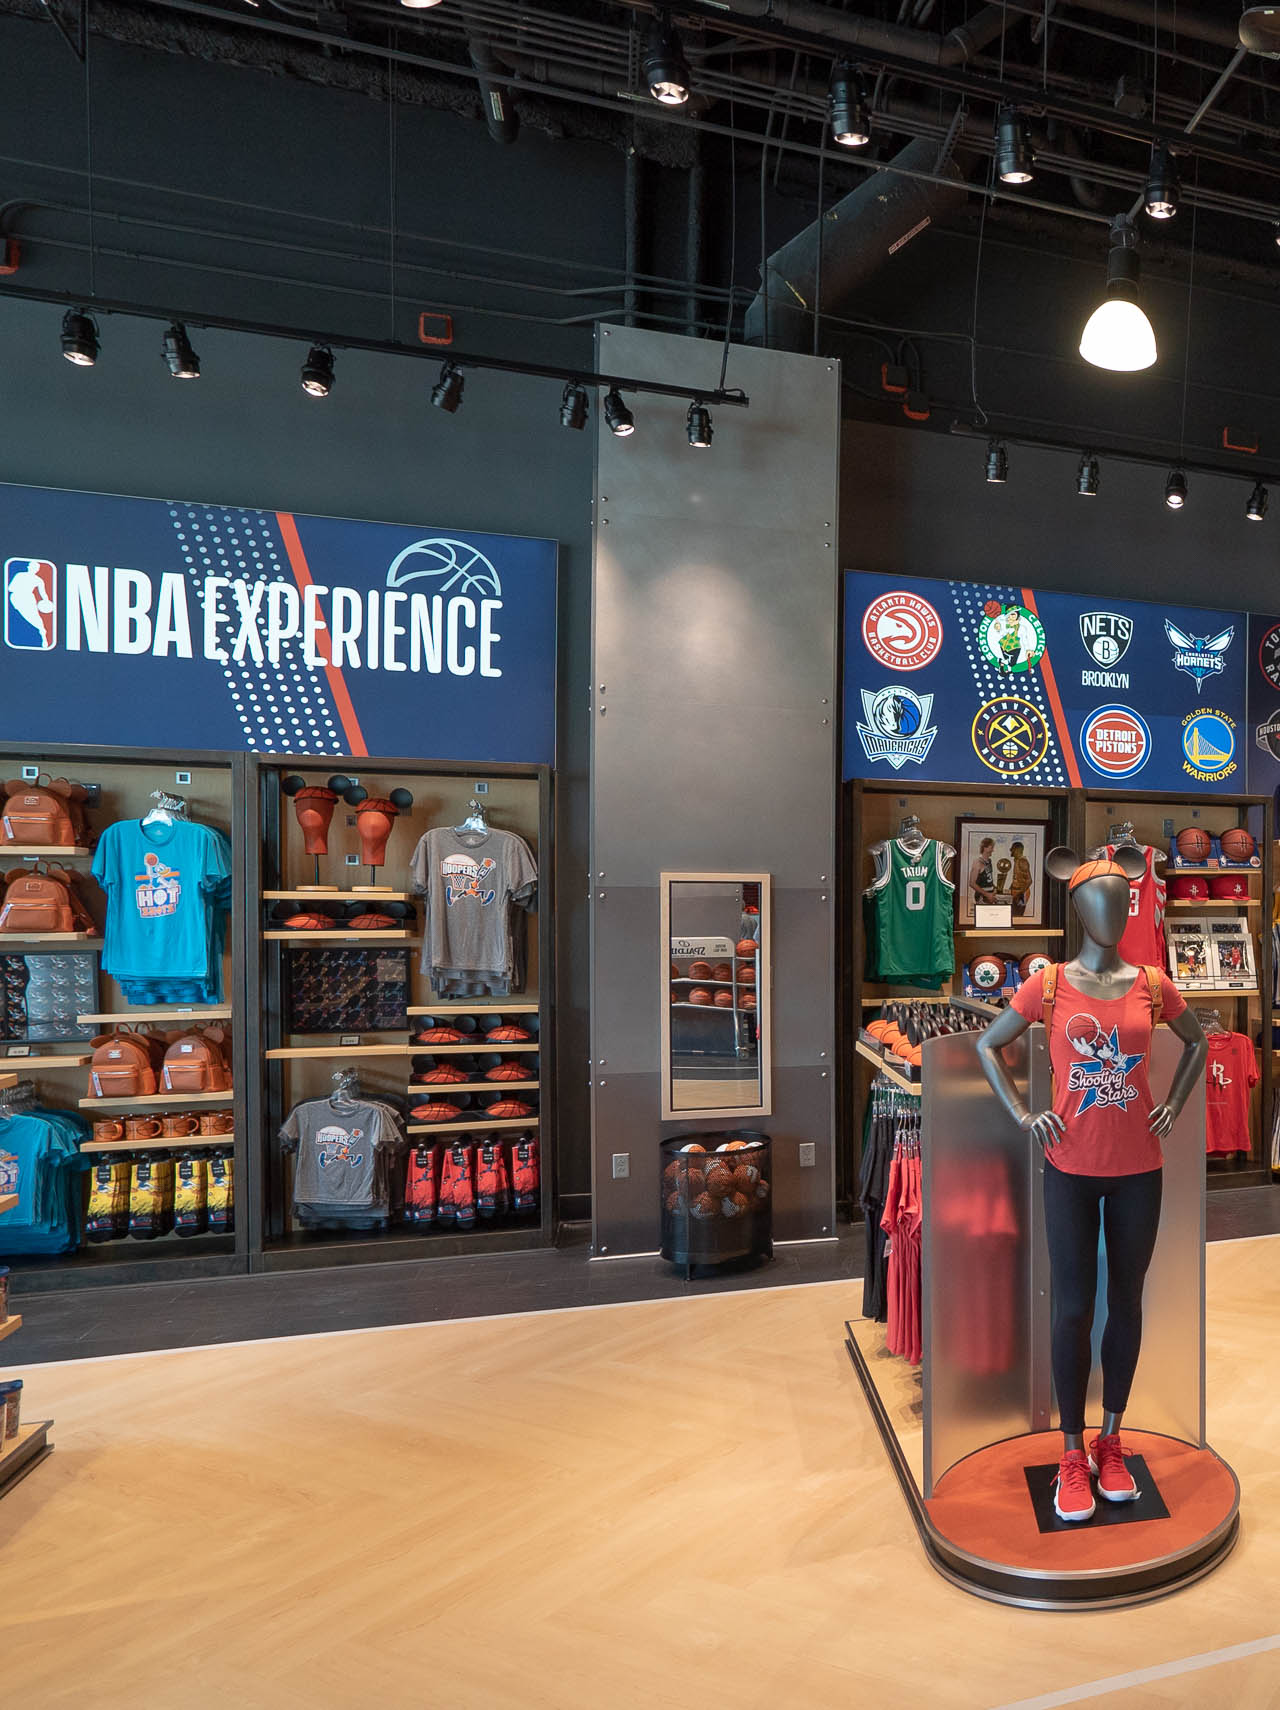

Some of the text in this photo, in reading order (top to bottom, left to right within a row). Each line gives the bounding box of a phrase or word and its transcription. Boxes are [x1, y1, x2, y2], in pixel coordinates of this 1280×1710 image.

[66, 563, 503, 677] NBA EXPERIENCE
[869, 597, 936, 627] ATLANTA HAWKS
[1028, 615, 1046, 658] CELTICS
[1083, 615, 1130, 640] NETS
[868, 631, 937, 665] BASKETBALL CLUB
[979, 617, 994, 661] BOSTON
[1102, 640, 1110, 660] B
[1176, 653, 1222, 670] HORNETS
[1082, 670, 1130, 688] BROOKLYN
[982, 702, 1038, 723] DENVER
[1181, 707, 1237, 729] GOLDEN STATE
[864, 733, 929, 755] MAVERICKS
[1095, 728, 1137, 742] DETROIT
[1095, 740, 1137, 754] PISTONS
[982, 747, 1039, 770] NUGGETS
[1181, 760, 1238, 782] WARRIORS
[900, 866, 929, 878] TATUM
[138, 888, 179, 907] HOT
[905, 881, 925, 910] 0
[1069, 1068, 1124, 1089] Shooting
[1096, 1084, 1136, 1104] Stars
